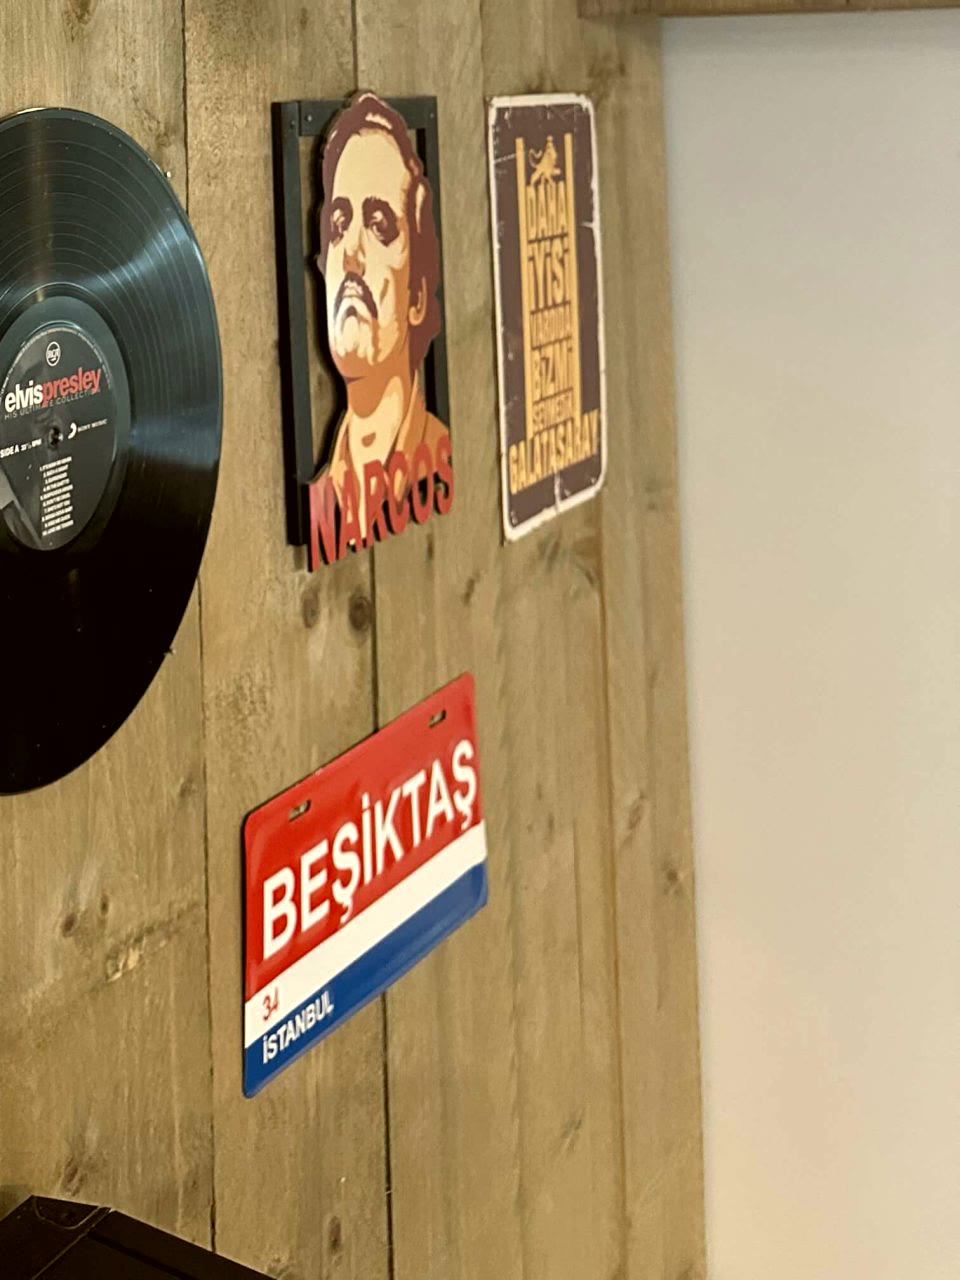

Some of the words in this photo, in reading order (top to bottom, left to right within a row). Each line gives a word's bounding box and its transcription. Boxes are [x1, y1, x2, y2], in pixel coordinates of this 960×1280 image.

[509, 408, 599, 495] GALATASARAY
[309, 434, 454, 571] NARCOS
[263, 739, 477, 960] BEŞİKTAŞ
[262, 987, 280, 1021] 34
[263, 991, 335, 1064] İSTANBUL
